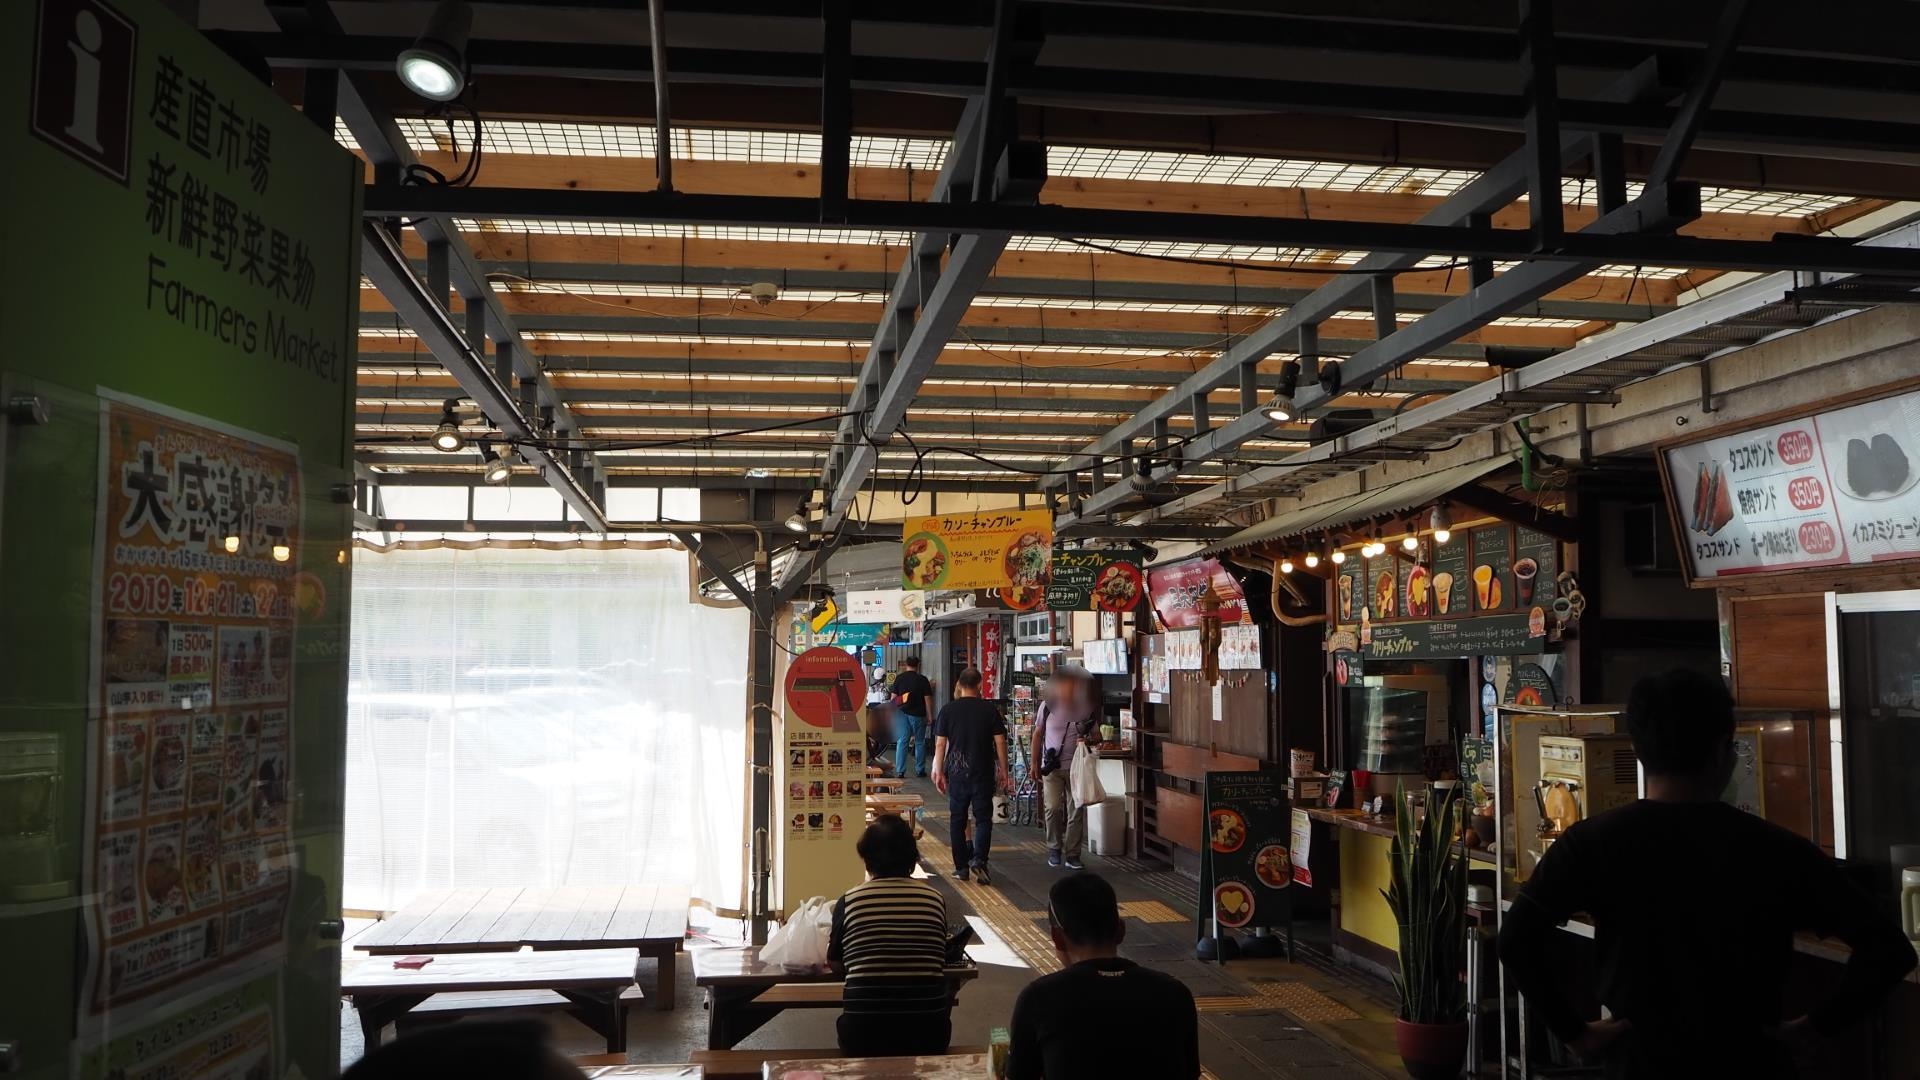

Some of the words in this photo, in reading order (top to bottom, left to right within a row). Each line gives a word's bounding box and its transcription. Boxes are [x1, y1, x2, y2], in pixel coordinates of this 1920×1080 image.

[149, 55, 271, 196] 産直市場
[146, 152, 317, 311] 新鮮野菜果物
[147, 252, 258, 355] Farmers
[264, 310, 339, 384] Market
[1728, 441, 1774, 473] タコスサンド
[1780, 433, 1810, 462] 350円
[1737, 486, 1776, 516] 焼肉サンド
[1791, 479, 1822, 508] 350円
[1695, 537, 1740, 561] タコスサンド
[1802, 524, 1834, 551] 230円
